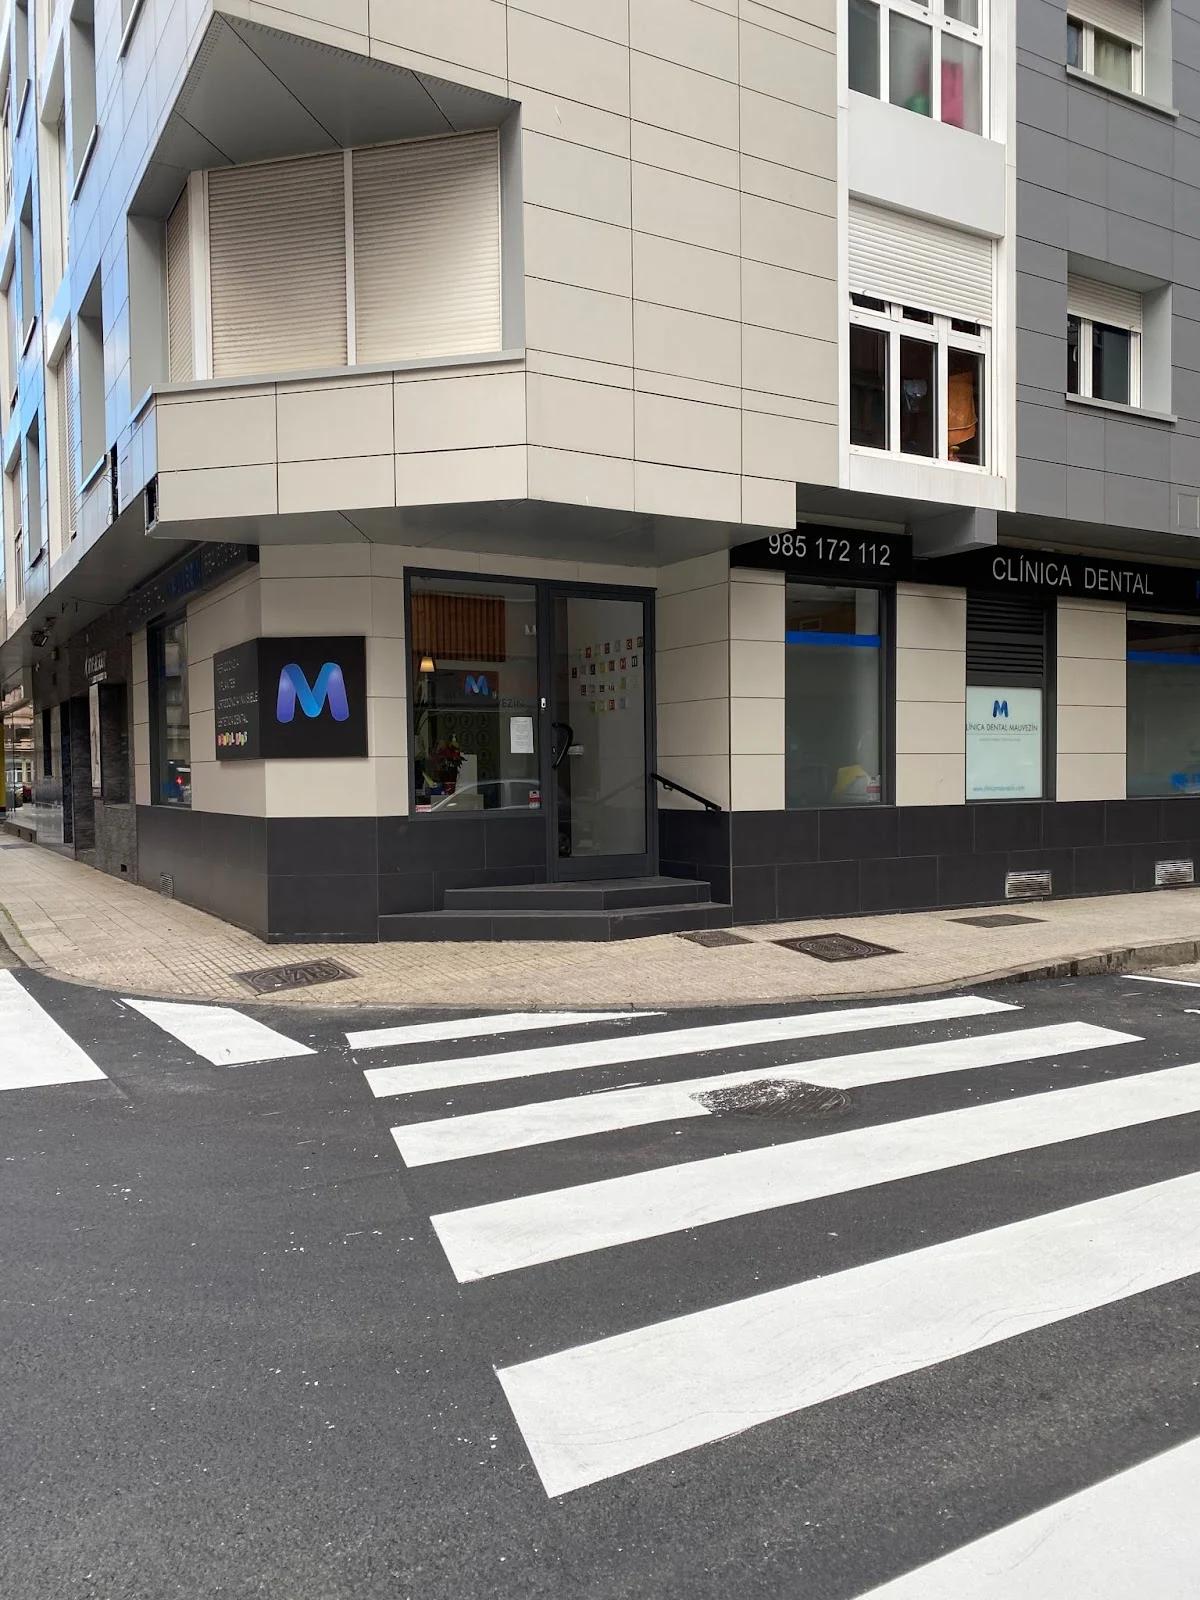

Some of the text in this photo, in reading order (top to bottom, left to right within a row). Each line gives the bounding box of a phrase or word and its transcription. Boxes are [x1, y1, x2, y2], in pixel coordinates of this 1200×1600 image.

[768, 533, 891, 566] 985 172 112
[992, 554, 1154, 596] CLÍNICA DENTAL
[276, 662, 350, 723] M
[992, 700, 1008, 717] M
[966, 722, 986, 732] LÍNICA
[986, 723, 1008, 732] DENTAL
